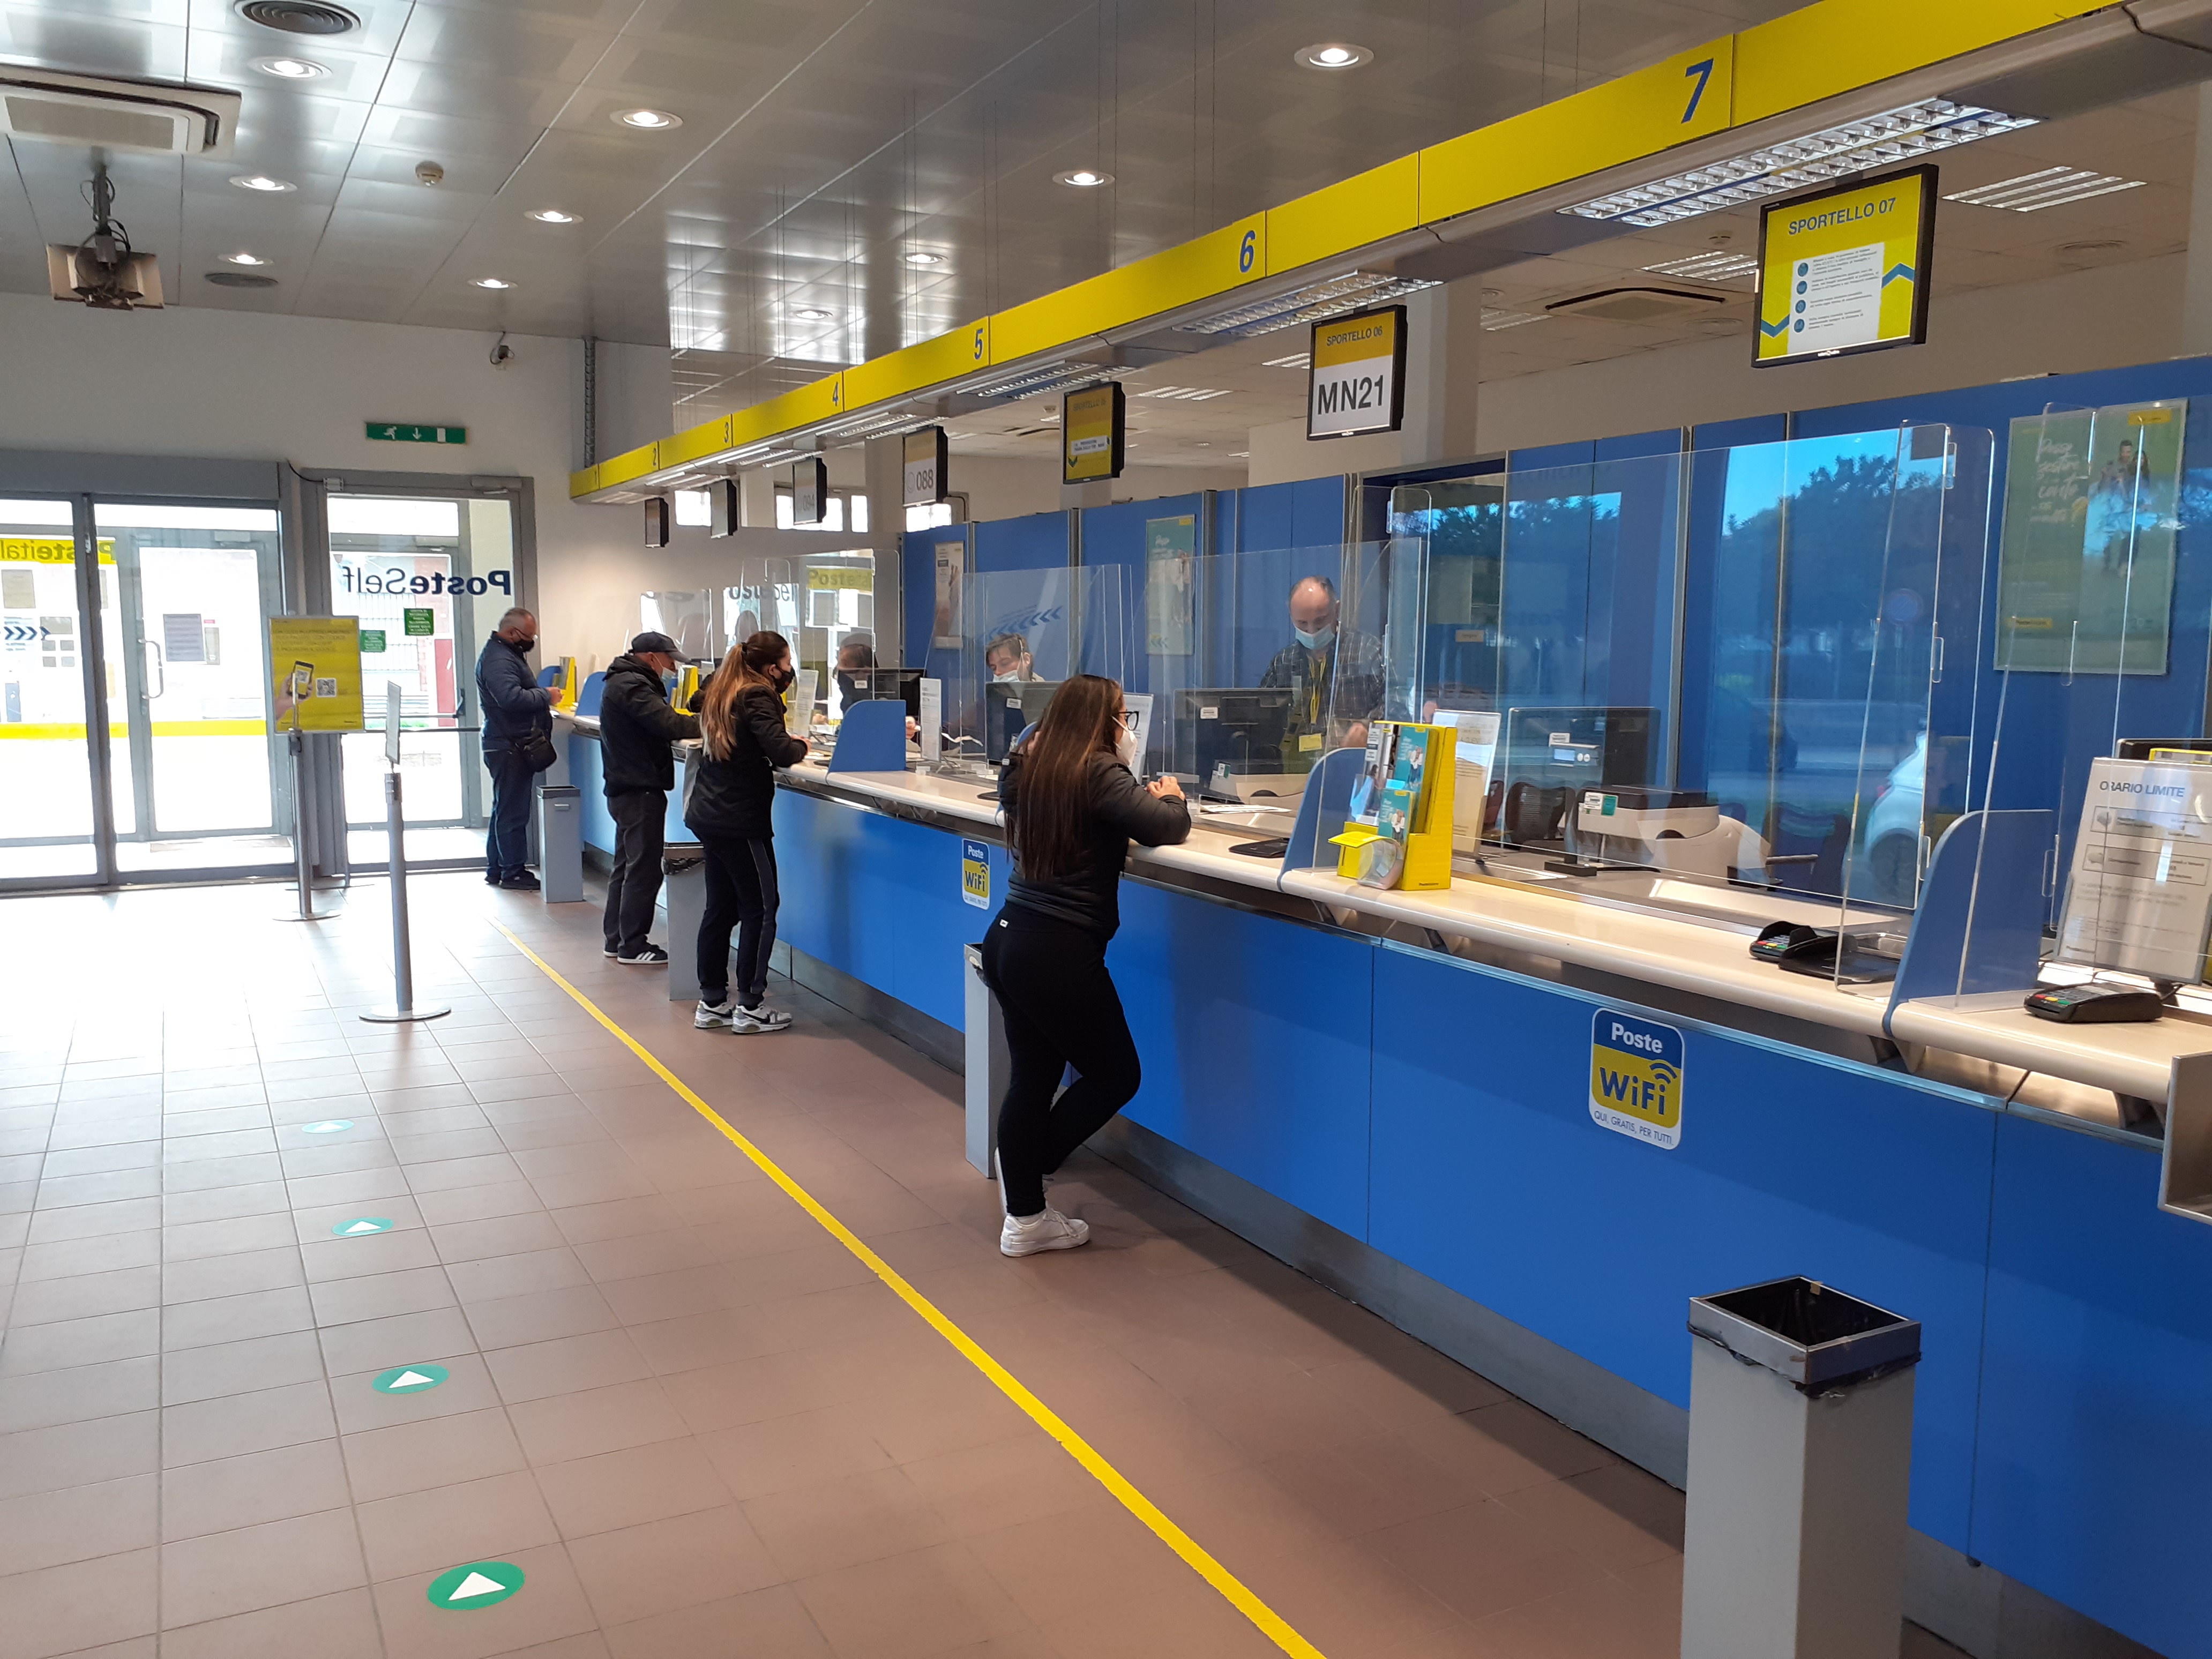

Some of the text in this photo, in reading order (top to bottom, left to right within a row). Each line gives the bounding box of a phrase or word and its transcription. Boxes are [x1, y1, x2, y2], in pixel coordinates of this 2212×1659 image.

[1680, 57, 1714, 124] 7
[1788, 197, 1896, 235] SPORTELLO 07
[1239, 229, 1256, 273] 6
[974, 327, 984, 360] 5
[1326, 325, 1383, 347] SPORTELLO 06
[832, 381, 839, 406] 4
[1318, 375, 1384, 415] MN21
[724, 421, 729, 443] 3
[653, 447, 657, 466] 2
[916, 468, 933, 491] 088
[2145, 784, 2185, 797] LIMITE
[967, 845, 984, 860] Poste
[965, 870, 985, 892] WiFi
[1611, 1022, 1663, 1054] Poste
[1600, 1066, 1665, 1115] WiFi
[1611, 1116, 1638, 1134] GRATIS,
[1639, 1126, 1651, 1138] PER
[1654, 1131, 1674, 1146] TUTTI.
